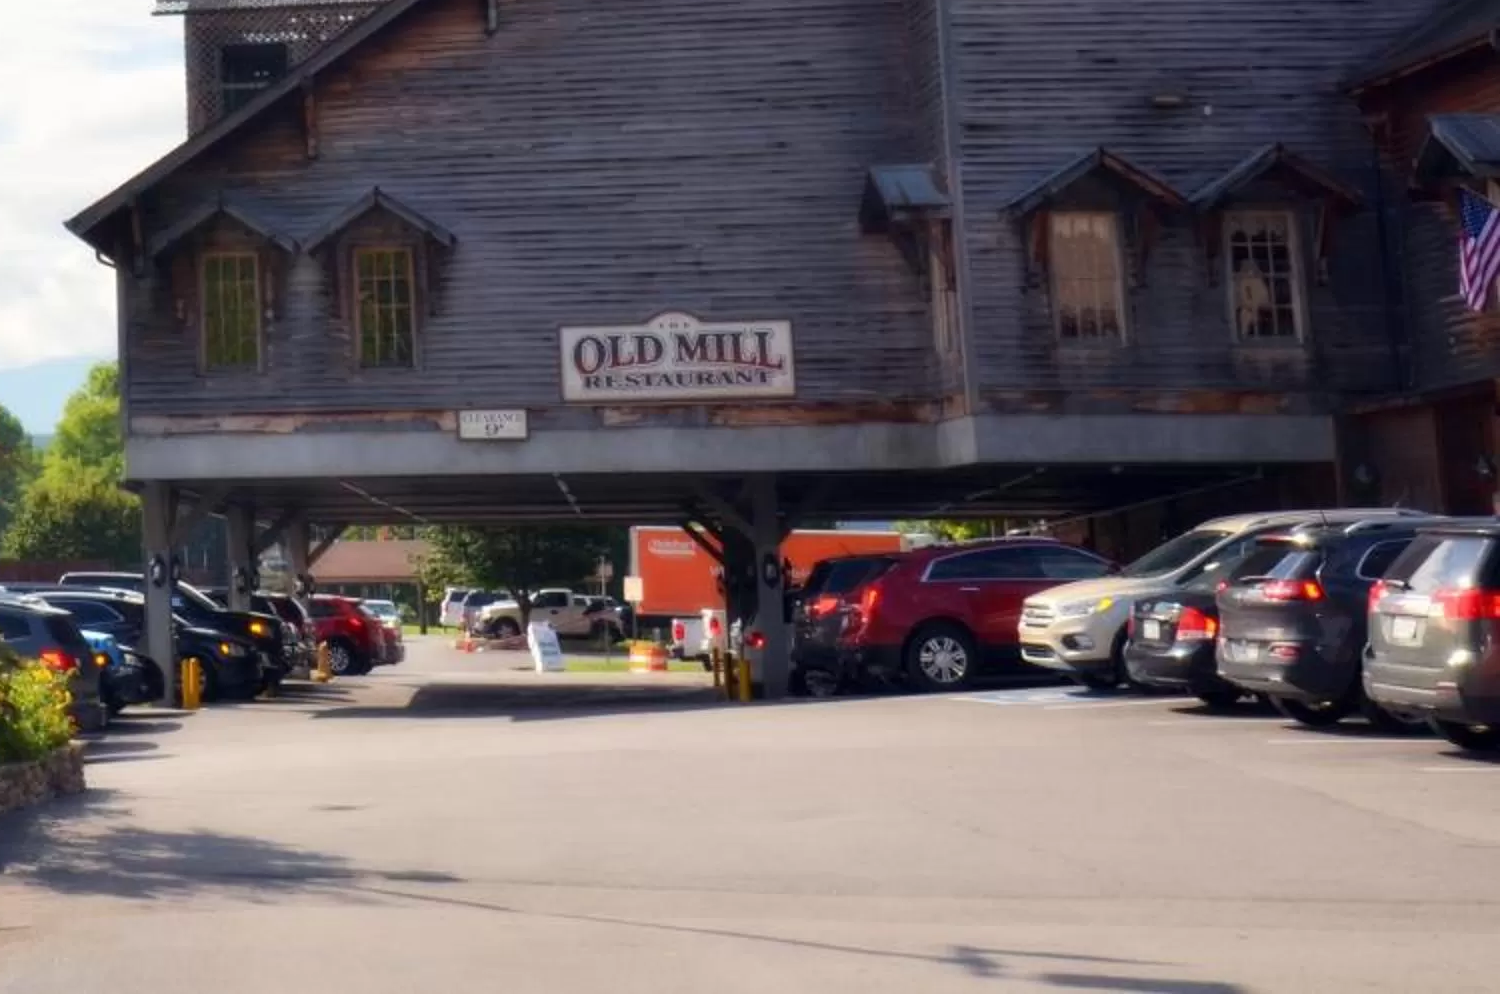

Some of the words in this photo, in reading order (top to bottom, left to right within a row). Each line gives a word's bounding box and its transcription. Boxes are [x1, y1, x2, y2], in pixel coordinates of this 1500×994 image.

[573, 334, 664, 376] OLD
[675, 330, 784, 371] MILL
[583, 370, 772, 390] RESTAURANT
